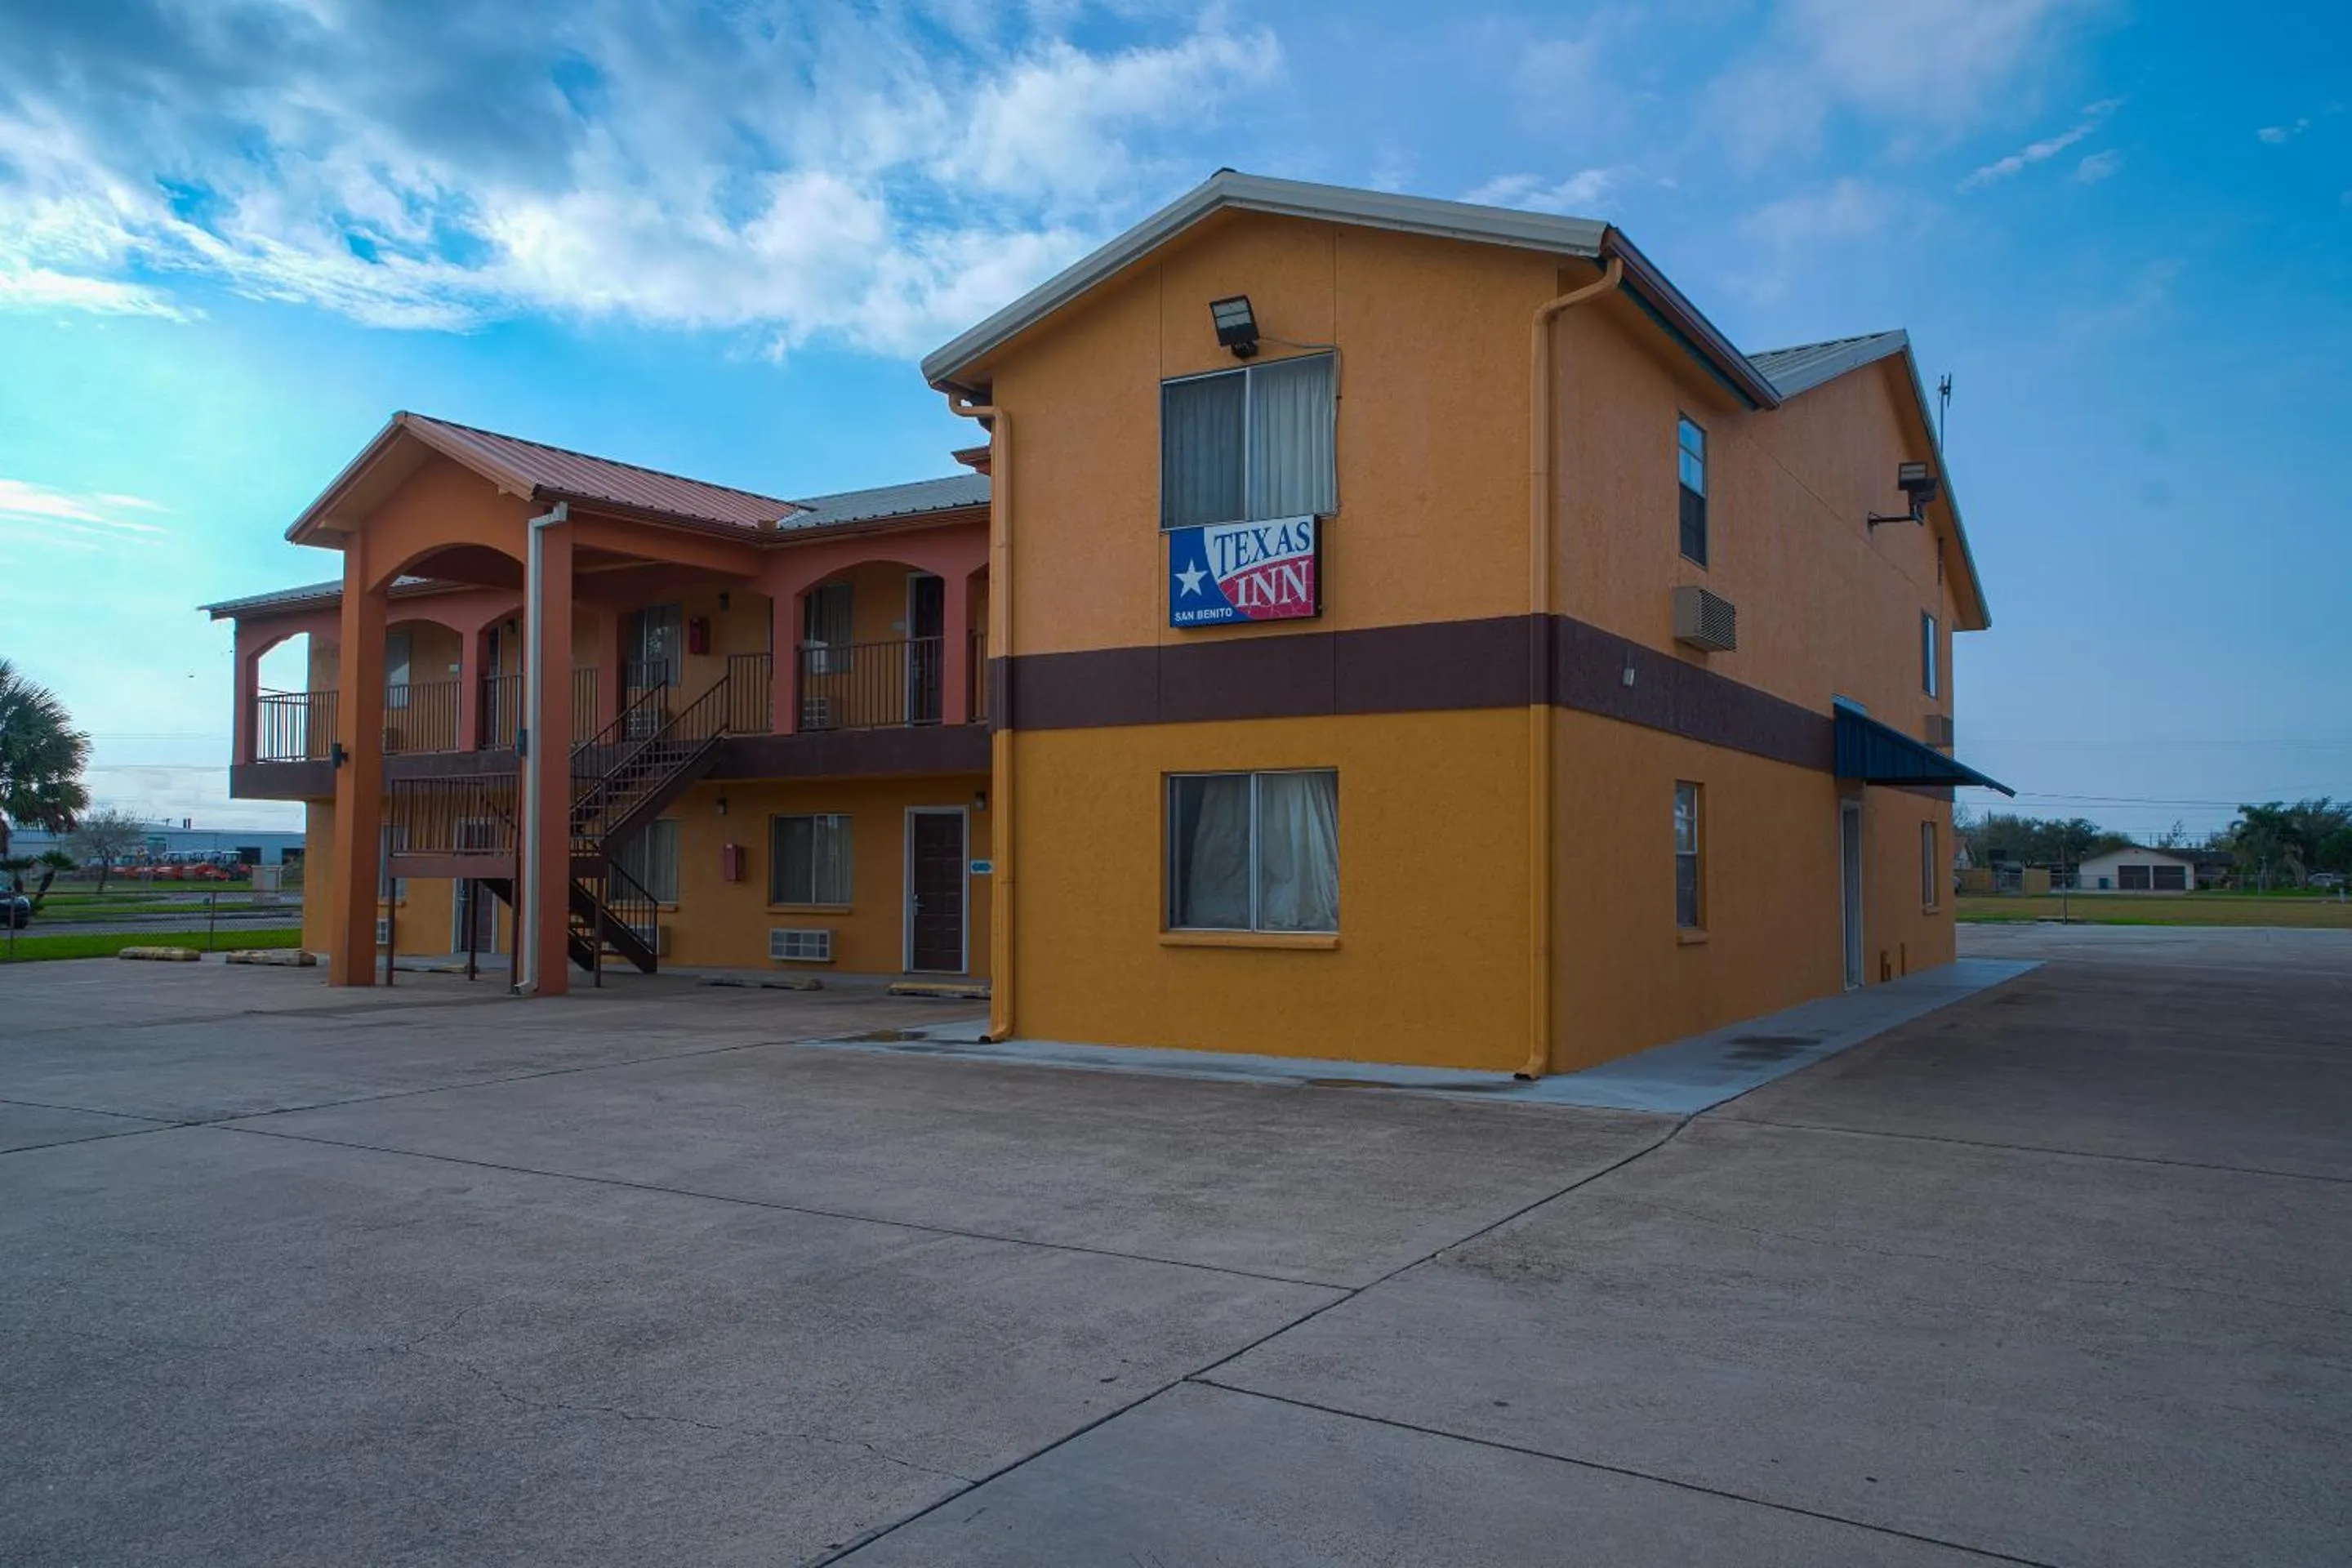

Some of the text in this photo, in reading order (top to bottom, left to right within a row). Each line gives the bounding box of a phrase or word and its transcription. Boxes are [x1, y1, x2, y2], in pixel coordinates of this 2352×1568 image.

[1214, 522, 1310, 577] TEXAS
[1236, 561, 1308, 607] INN
[1174, 608, 1233, 621] SAN BENITO
